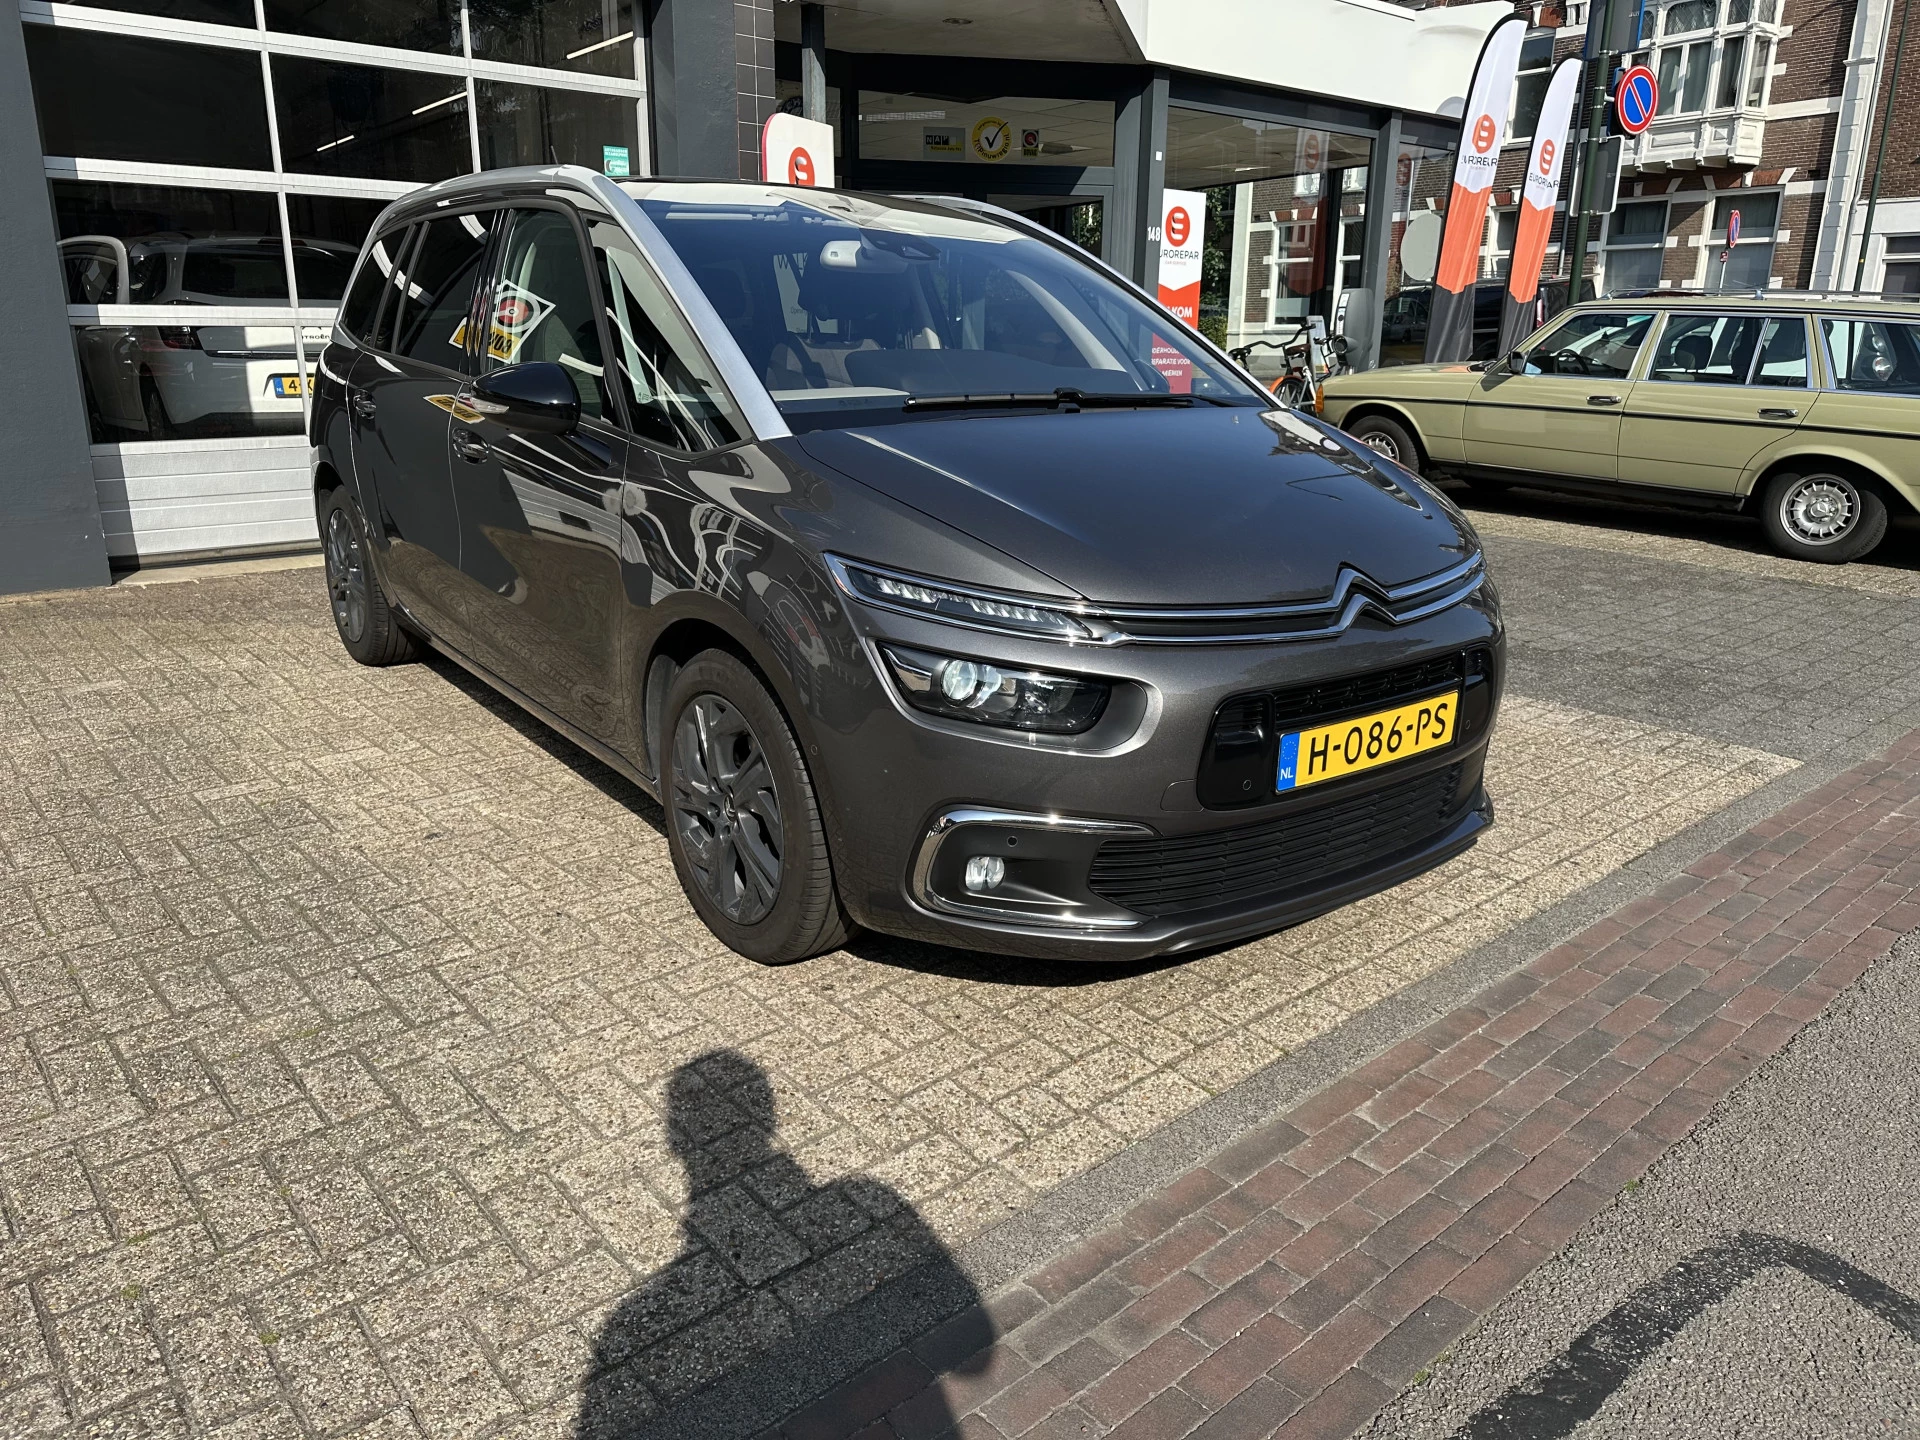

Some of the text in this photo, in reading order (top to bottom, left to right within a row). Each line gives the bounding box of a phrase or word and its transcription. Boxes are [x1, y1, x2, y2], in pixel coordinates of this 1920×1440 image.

[1147, 226, 1161, 242] 148
[1160, 248, 1200, 261] UROREPAR
[1166, 305, 1193, 318] KOM
[1279, 702, 1449, 781] NL H-086-PS
